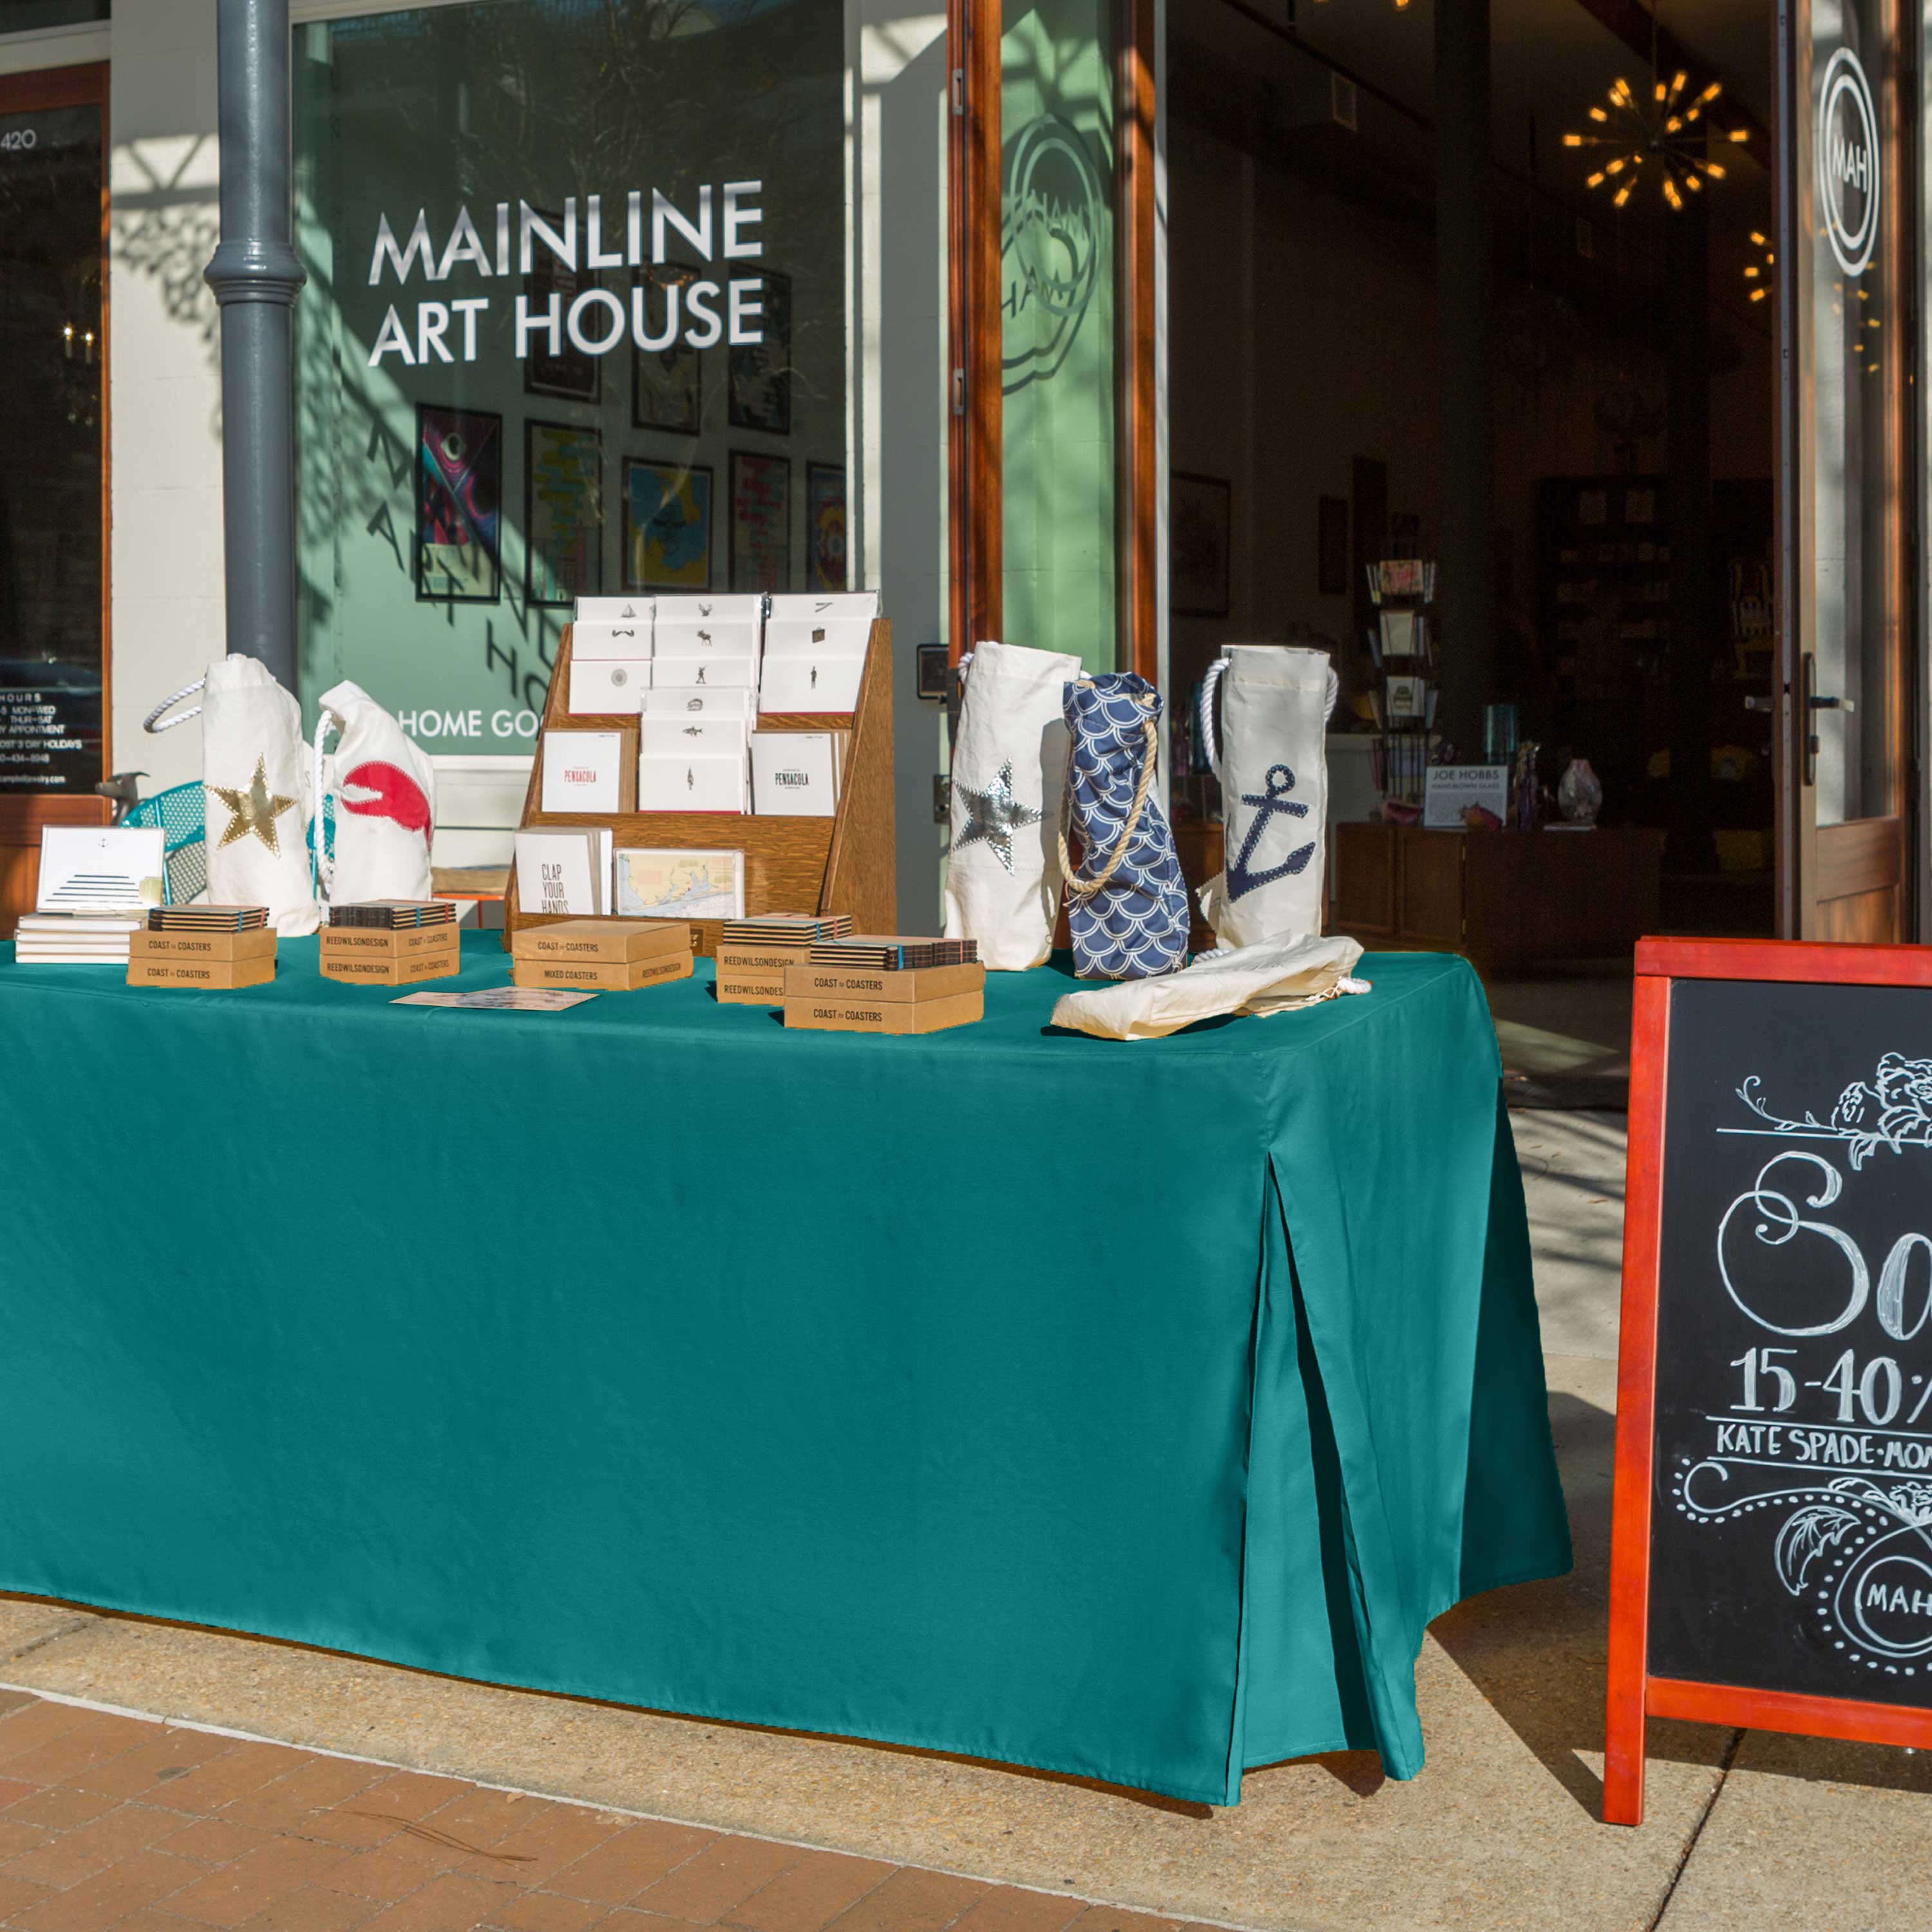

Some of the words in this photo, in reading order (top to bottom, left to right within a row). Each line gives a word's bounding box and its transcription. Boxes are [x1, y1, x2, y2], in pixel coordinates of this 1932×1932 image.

[1, 129, 37, 151] 420
[1832, 135, 1867, 193] MAH
[368, 180, 762, 285] MAINLINE
[368, 298, 489, 367] ART
[515, 278, 762, 358] HOUSE
[398, 710, 482, 737] HOME
[564, 770, 596, 782] PENSACOLA
[775, 773, 809, 786] PENSACOLA
[1432, 770, 1455, 781] JOE
[1459, 770, 1499, 780] HOBBS
[542, 864, 562, 880] CLAP
[542, 882, 565, 898] YOUR
[542, 899, 569, 914] HANDS
[149, 940, 170, 949] COAST
[178, 942, 211, 951] COASTERS
[327, 936, 388, 947] REEDWILSONDESIGN
[537, 941, 558, 951] COAST
[566, 942, 599, 952] COASTERS
[724, 956, 794, 967] REEDWILSONDESIGN
[147, 968, 169, 977] COAST
[176, 969, 211, 979] COASTERS
[327, 963, 390, 974] REEDWILSONDESIGN
[544, 970, 564, 978] MIXED
[565, 971, 598, 980] COASTERS
[814, 978, 838, 988] COAST
[846, 980, 883, 990] COASTERS
[813, 1009, 837, 1019] COAST
[845, 1010, 882, 1022] COASTERS
[1716, 1424, 1782, 1455] KATE
[1866, 1583, 1932, 1616] MAH
